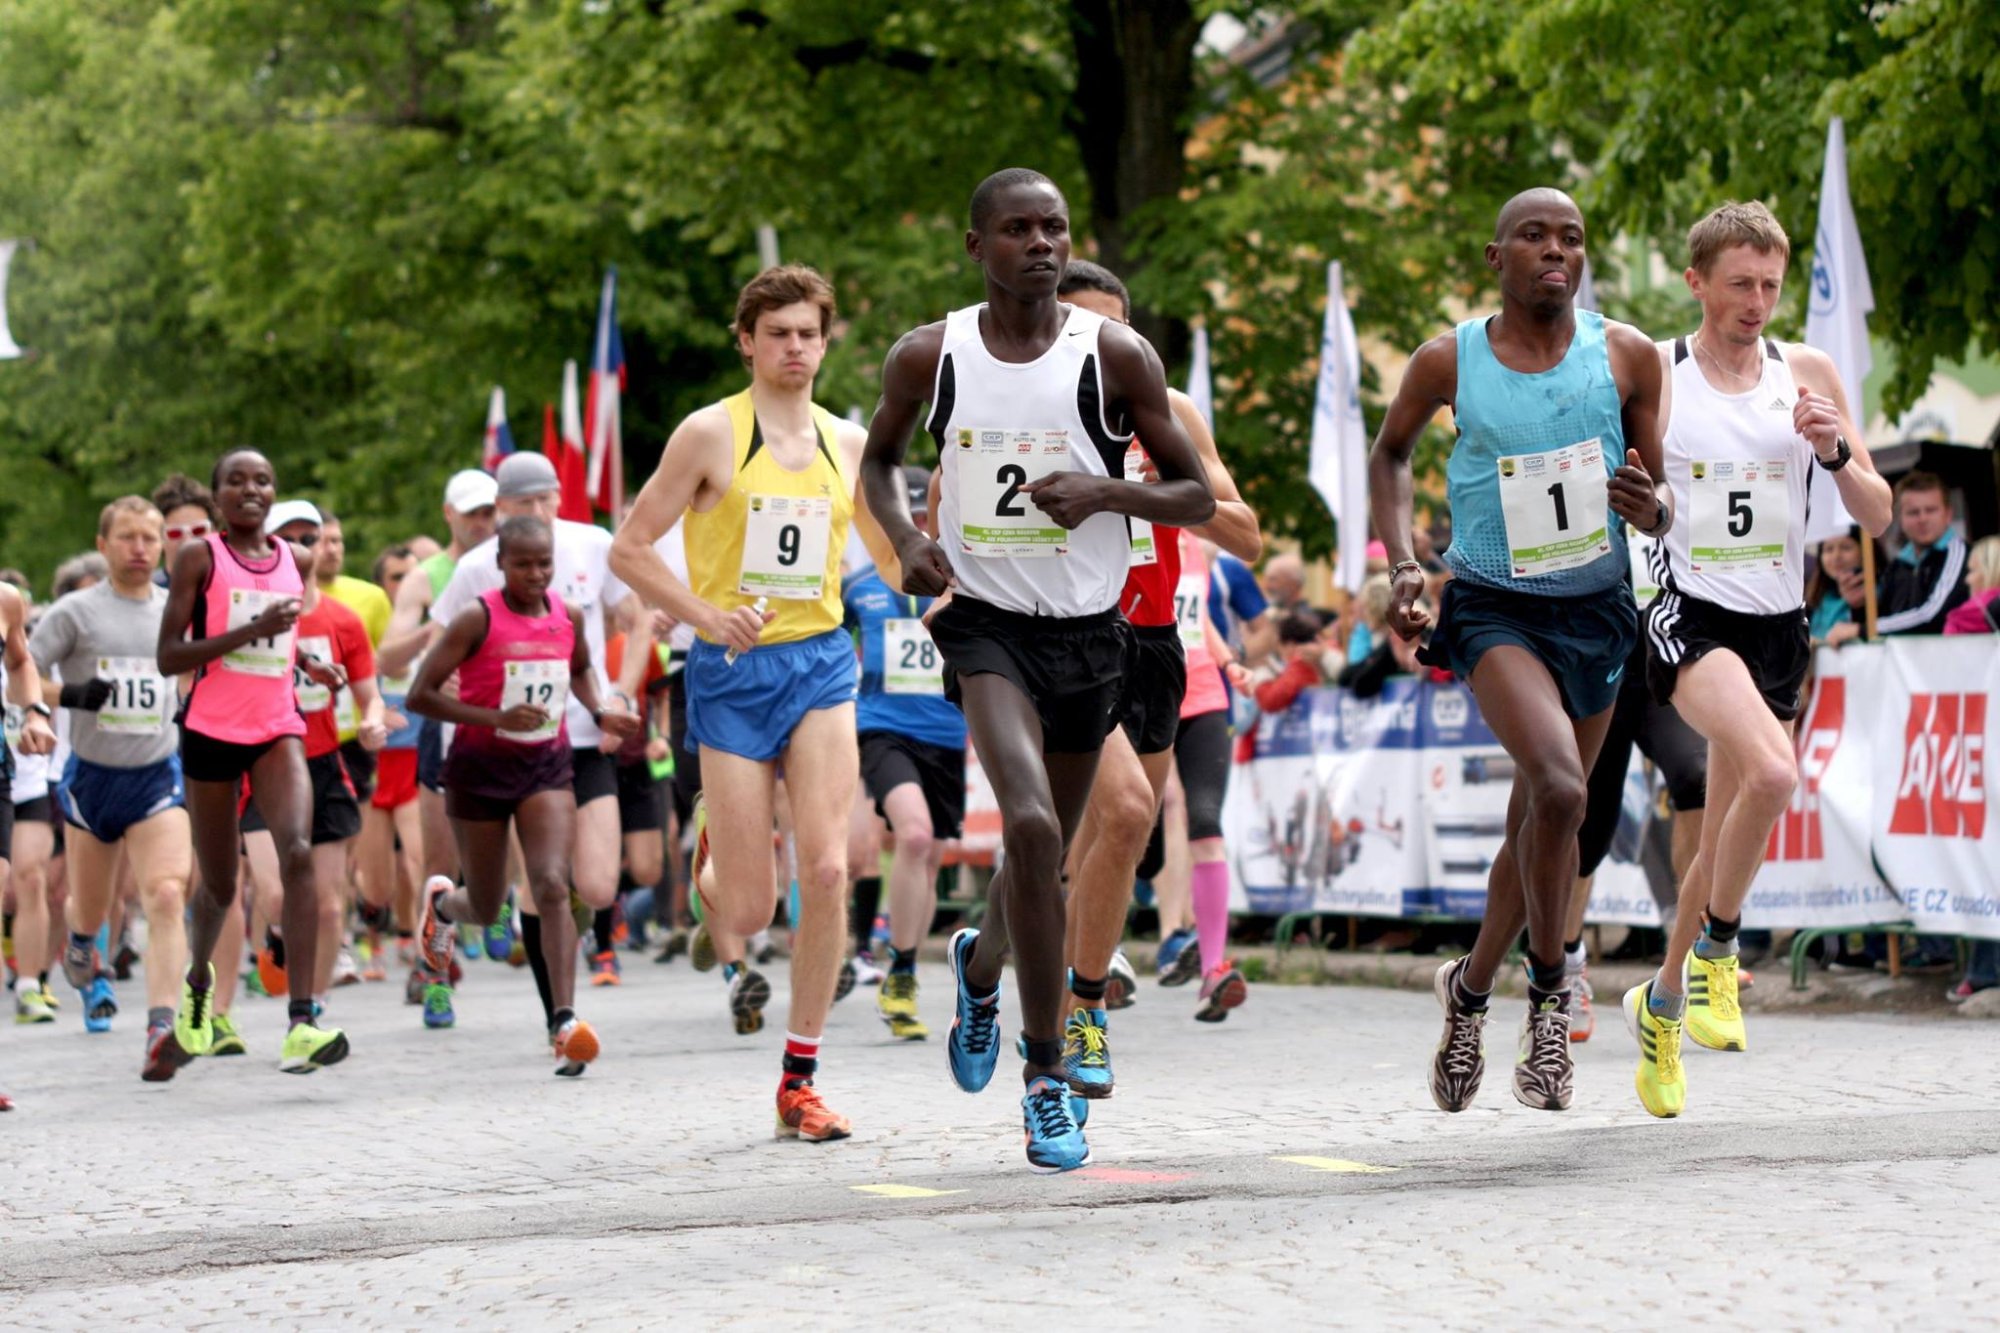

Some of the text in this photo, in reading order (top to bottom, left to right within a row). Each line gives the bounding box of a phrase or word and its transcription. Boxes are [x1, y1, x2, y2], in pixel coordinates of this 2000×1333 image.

[996, 463, 1027, 517] 2
[1547, 481, 1569, 531] 1
[1727, 490, 1754, 538] 5
[777, 523, 801, 567] 9
[1174, 594, 1199, 625] 74
[900, 638, 936, 670] 28
[111, 677, 156, 709] 115
[1898, 733, 1985, 804] AVE
[1925, 888, 1949, 914] CZ
